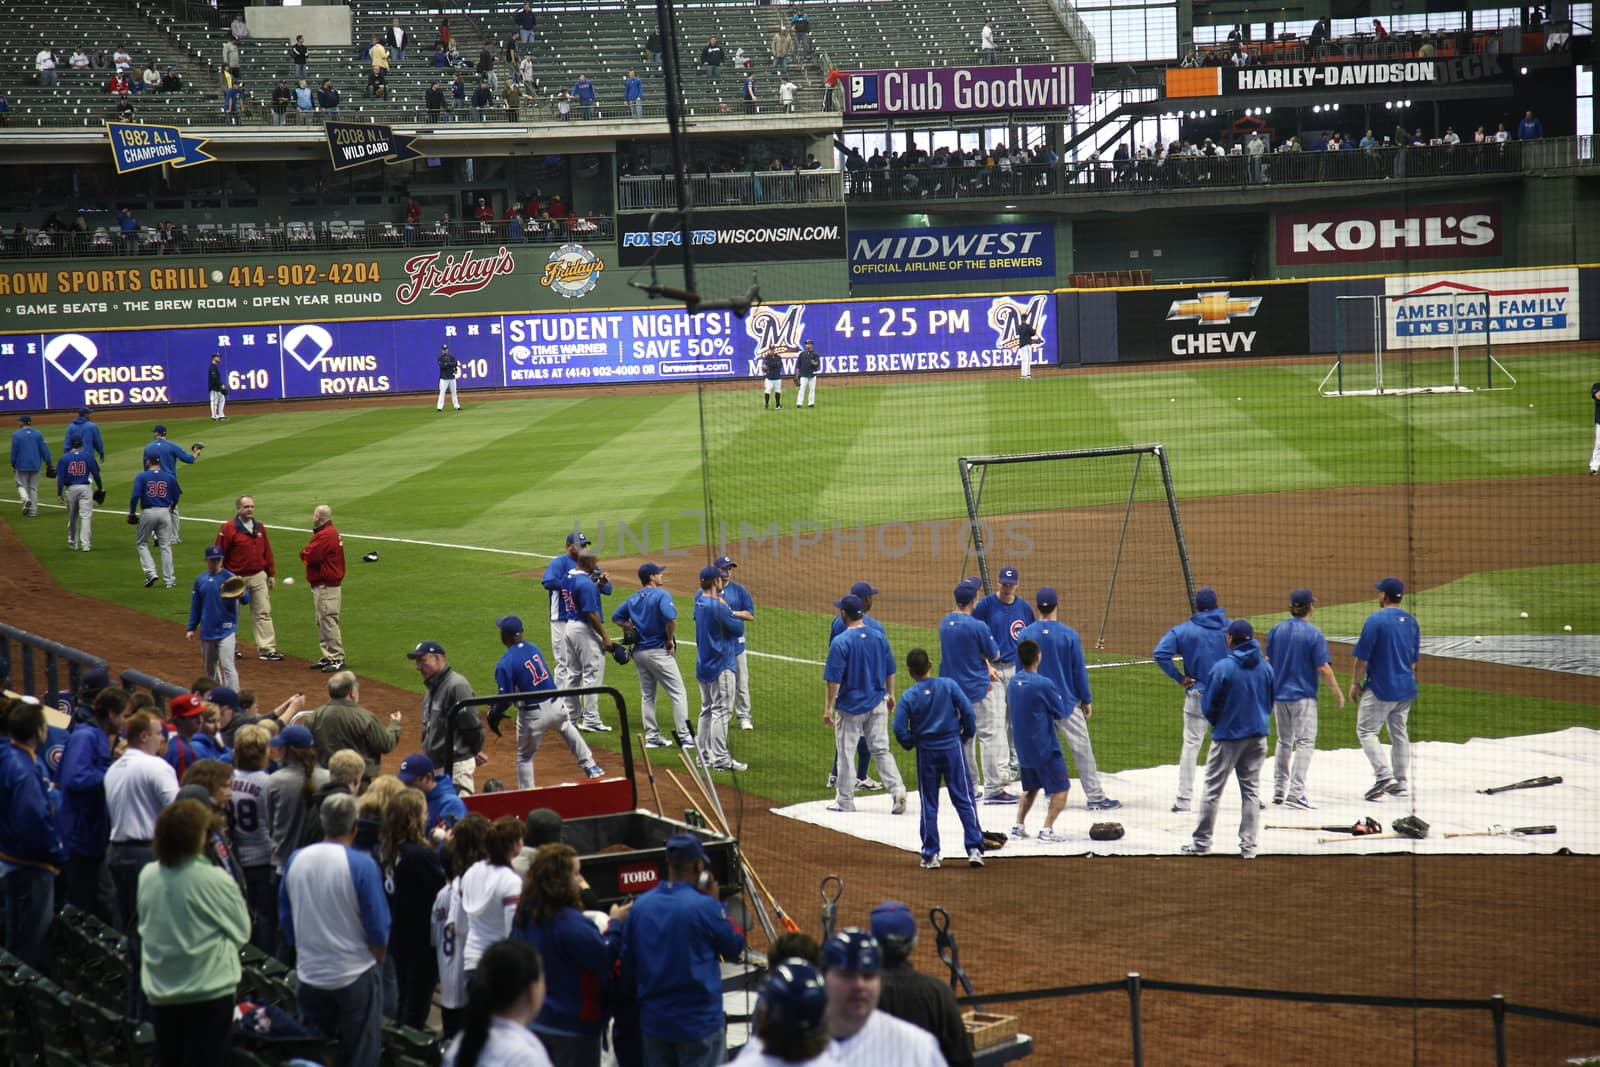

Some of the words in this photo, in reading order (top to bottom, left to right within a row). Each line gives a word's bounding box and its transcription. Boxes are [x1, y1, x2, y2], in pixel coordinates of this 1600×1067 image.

[1238, 61, 1435, 90] HARLEY-DAVIDSON
[884, 71, 942, 111] Club
[954, 66, 1075, 110] Goodwill
[118, 129, 151, 146] 1982
[154, 131, 176, 145] A.L.
[334, 128, 365, 145] 2008
[367, 129, 389, 142] N.L.
[123, 144, 178, 163] CHAMPIONS
[342, 144, 365, 161] WILD
[366, 142, 389, 156] CARD
[1293, 215, 1495, 253] KOHL'S
[853, 231, 1042, 261] MIDWEST
[395, 245, 515, 305] Friday's
[539, 257, 605, 287] Friday's
[853, 263, 901, 274] OFFICIAL
[904, 261, 946, 273] AIRLINE
[949, 260, 963, 271] OF
[965, 259, 986, 270] THE
[989, 257, 1043, 269] BREWERS
[0, 271, 48, 295] ROW
[57, 268, 142, 293] SPORTS
[149, 266, 208, 291] GRILL
[228, 262, 381, 288] 414-902-4204
[16, 304, 57, 315] GAME
[62, 302, 108, 314] SEATS
[123, 300, 150, 312] THE
[154, 299, 193, 311] BREW
[197, 298, 237, 309] ROOM
[252, 296, 290, 308] OPEN
[294, 294, 329, 305] YEAR
[334, 292, 383, 304] ROUND
[1396, 301, 1489, 320] AMERICAN
[1499, 297, 1567, 315] FAMILY
[445, 325, 457, 337] R
[467, 324, 479, 336] H
[490, 323, 501, 335] E
[509, 316, 622, 343] STUDENT
[632, 312, 731, 338] NIGHTS!
[834, 307, 917, 338] 4:25
[929, 309, 970, 335] PM
[1408, 317, 1553, 334] INSURANCE
[218, 335, 231, 346] R
[242, 334, 255, 346] H
[267, 333, 278, 344] E
[531, 345, 559, 356] TIME
[560, 343, 608, 355] WARNER
[633, 340, 682, 359] SAVE
[688, 338, 734, 357] 50%
[1170, 330, 1256, 355] CHEVY
[320, 355, 377, 373] TWINS
[511, 369, 549, 380] DETAILS
[551, 368, 563, 379] AT
[566, 366, 591, 378] (414)
[643, 364, 655, 375] OR
[865, 351, 950, 373] BREWERS
[83, 365, 165, 384] ORIOLES
[228, 369, 269, 390] 6:10
[320, 375, 390, 394] ROYALS
[84, 388, 125, 406] RED
[129, 386, 168, 404] SOX
[67, 461, 87, 476] 40
[147, 480, 168, 498] 36
[523, 654, 549, 687] 11
[621, 869, 656, 885] TORO
